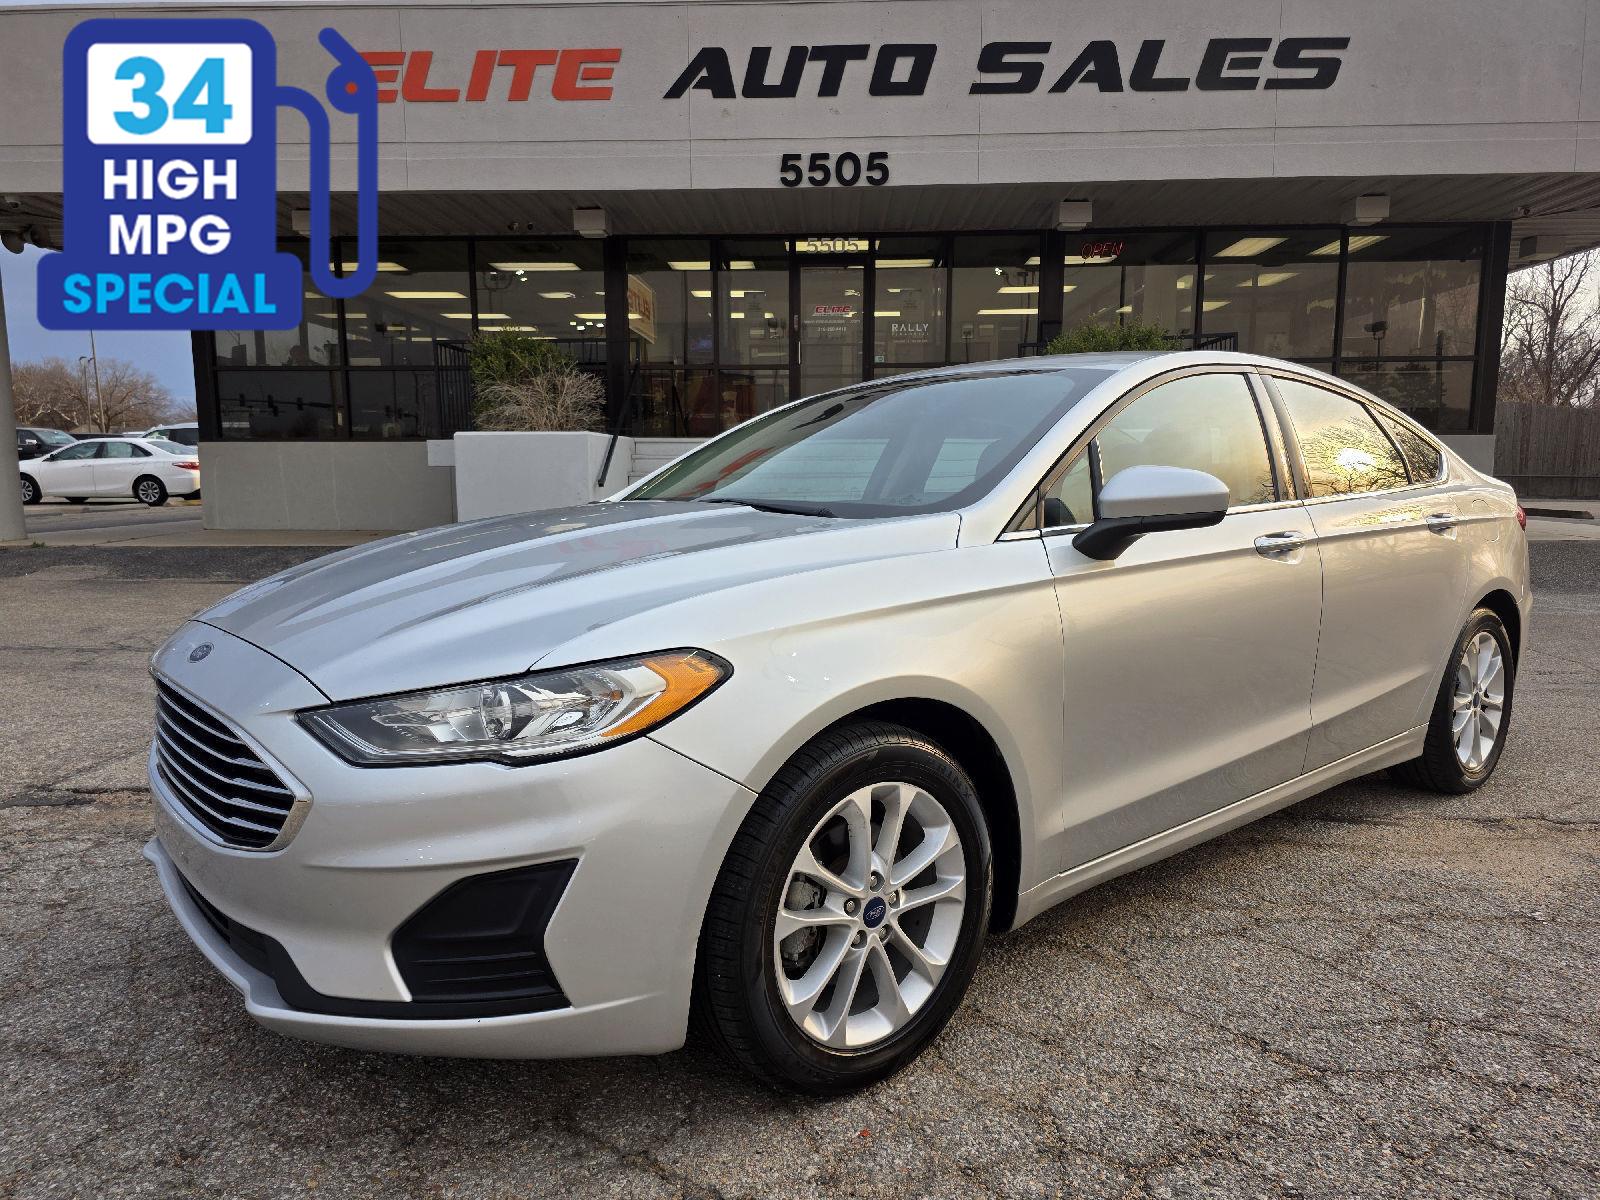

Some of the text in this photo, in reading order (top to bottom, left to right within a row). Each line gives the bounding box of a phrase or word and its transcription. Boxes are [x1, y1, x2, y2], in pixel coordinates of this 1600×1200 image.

[662, 43, 937, 99] AUTO
[968, 37, 1351, 95] SALES
[780, 151, 890, 187] 5505
[806, 237, 859, 254] 5505
[1081, 241, 1124, 259] OPEN
[891, 323, 929, 332] RALLY
